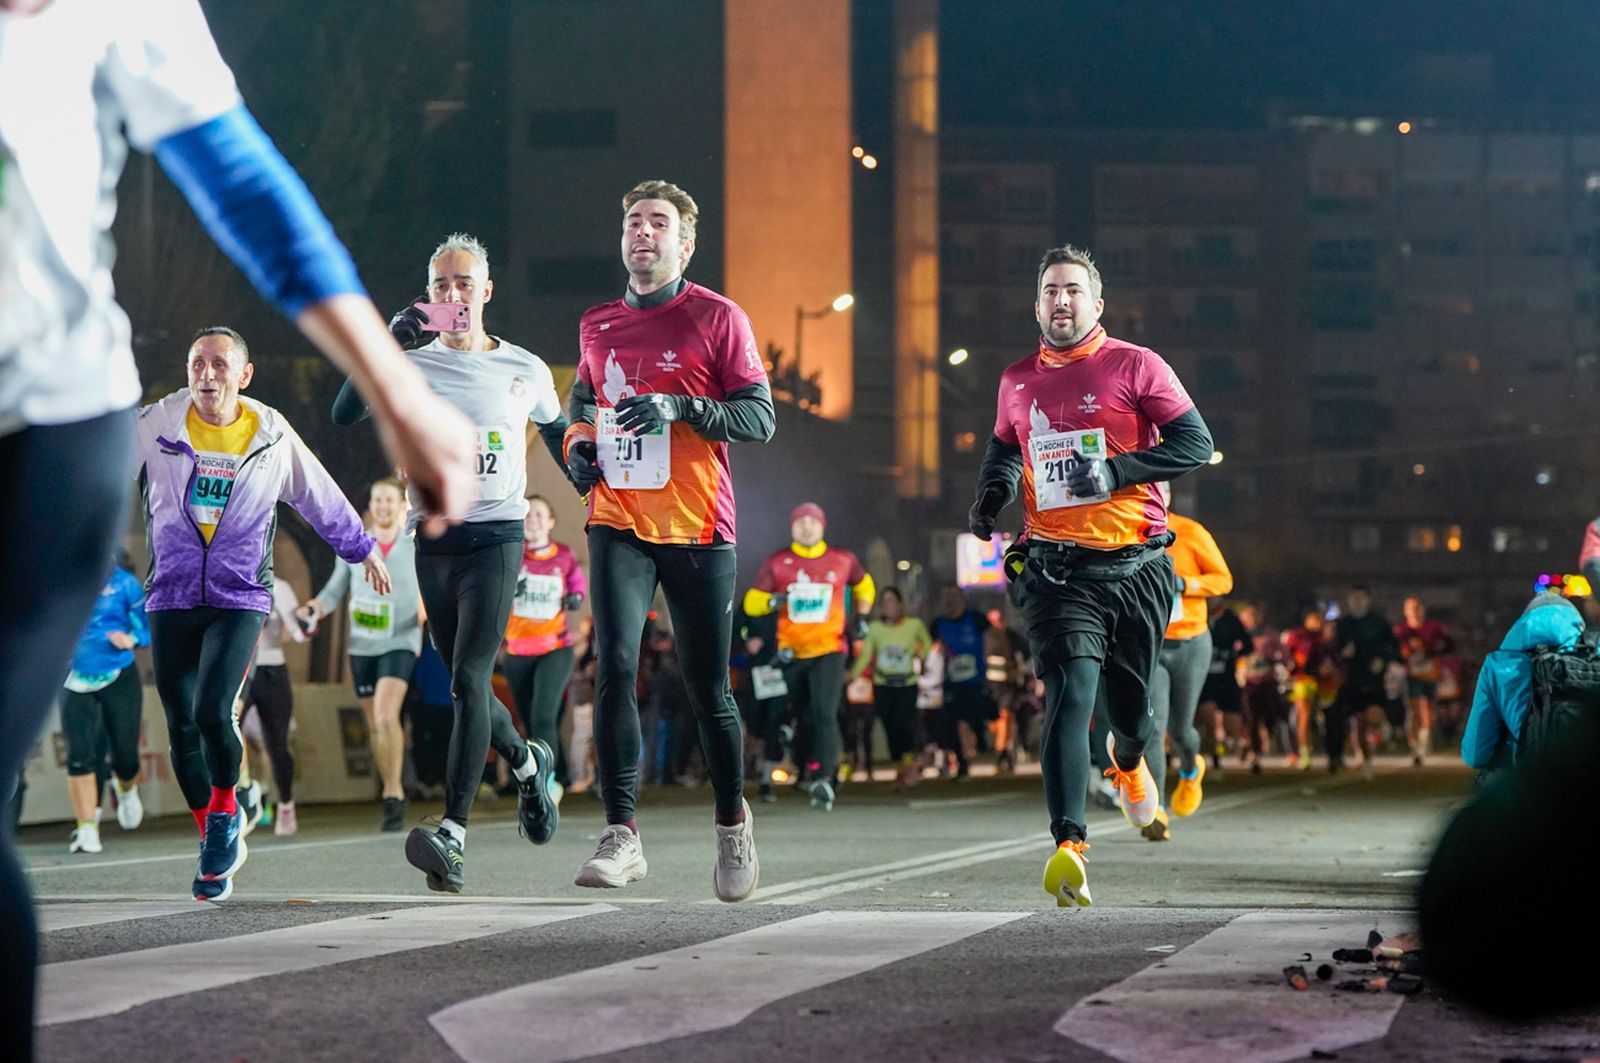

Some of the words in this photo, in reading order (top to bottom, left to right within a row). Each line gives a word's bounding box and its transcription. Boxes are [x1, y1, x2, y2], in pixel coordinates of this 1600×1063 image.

[615, 437, 642, 461] 701
[1043, 441, 1065, 450] NOCHE
[1066, 439, 1074, 448] DE
[201, 459, 224, 469] NOCHE
[226, 462, 235, 470] DE
[196, 467, 207, 475] AN
[196, 477, 234, 500] 944
